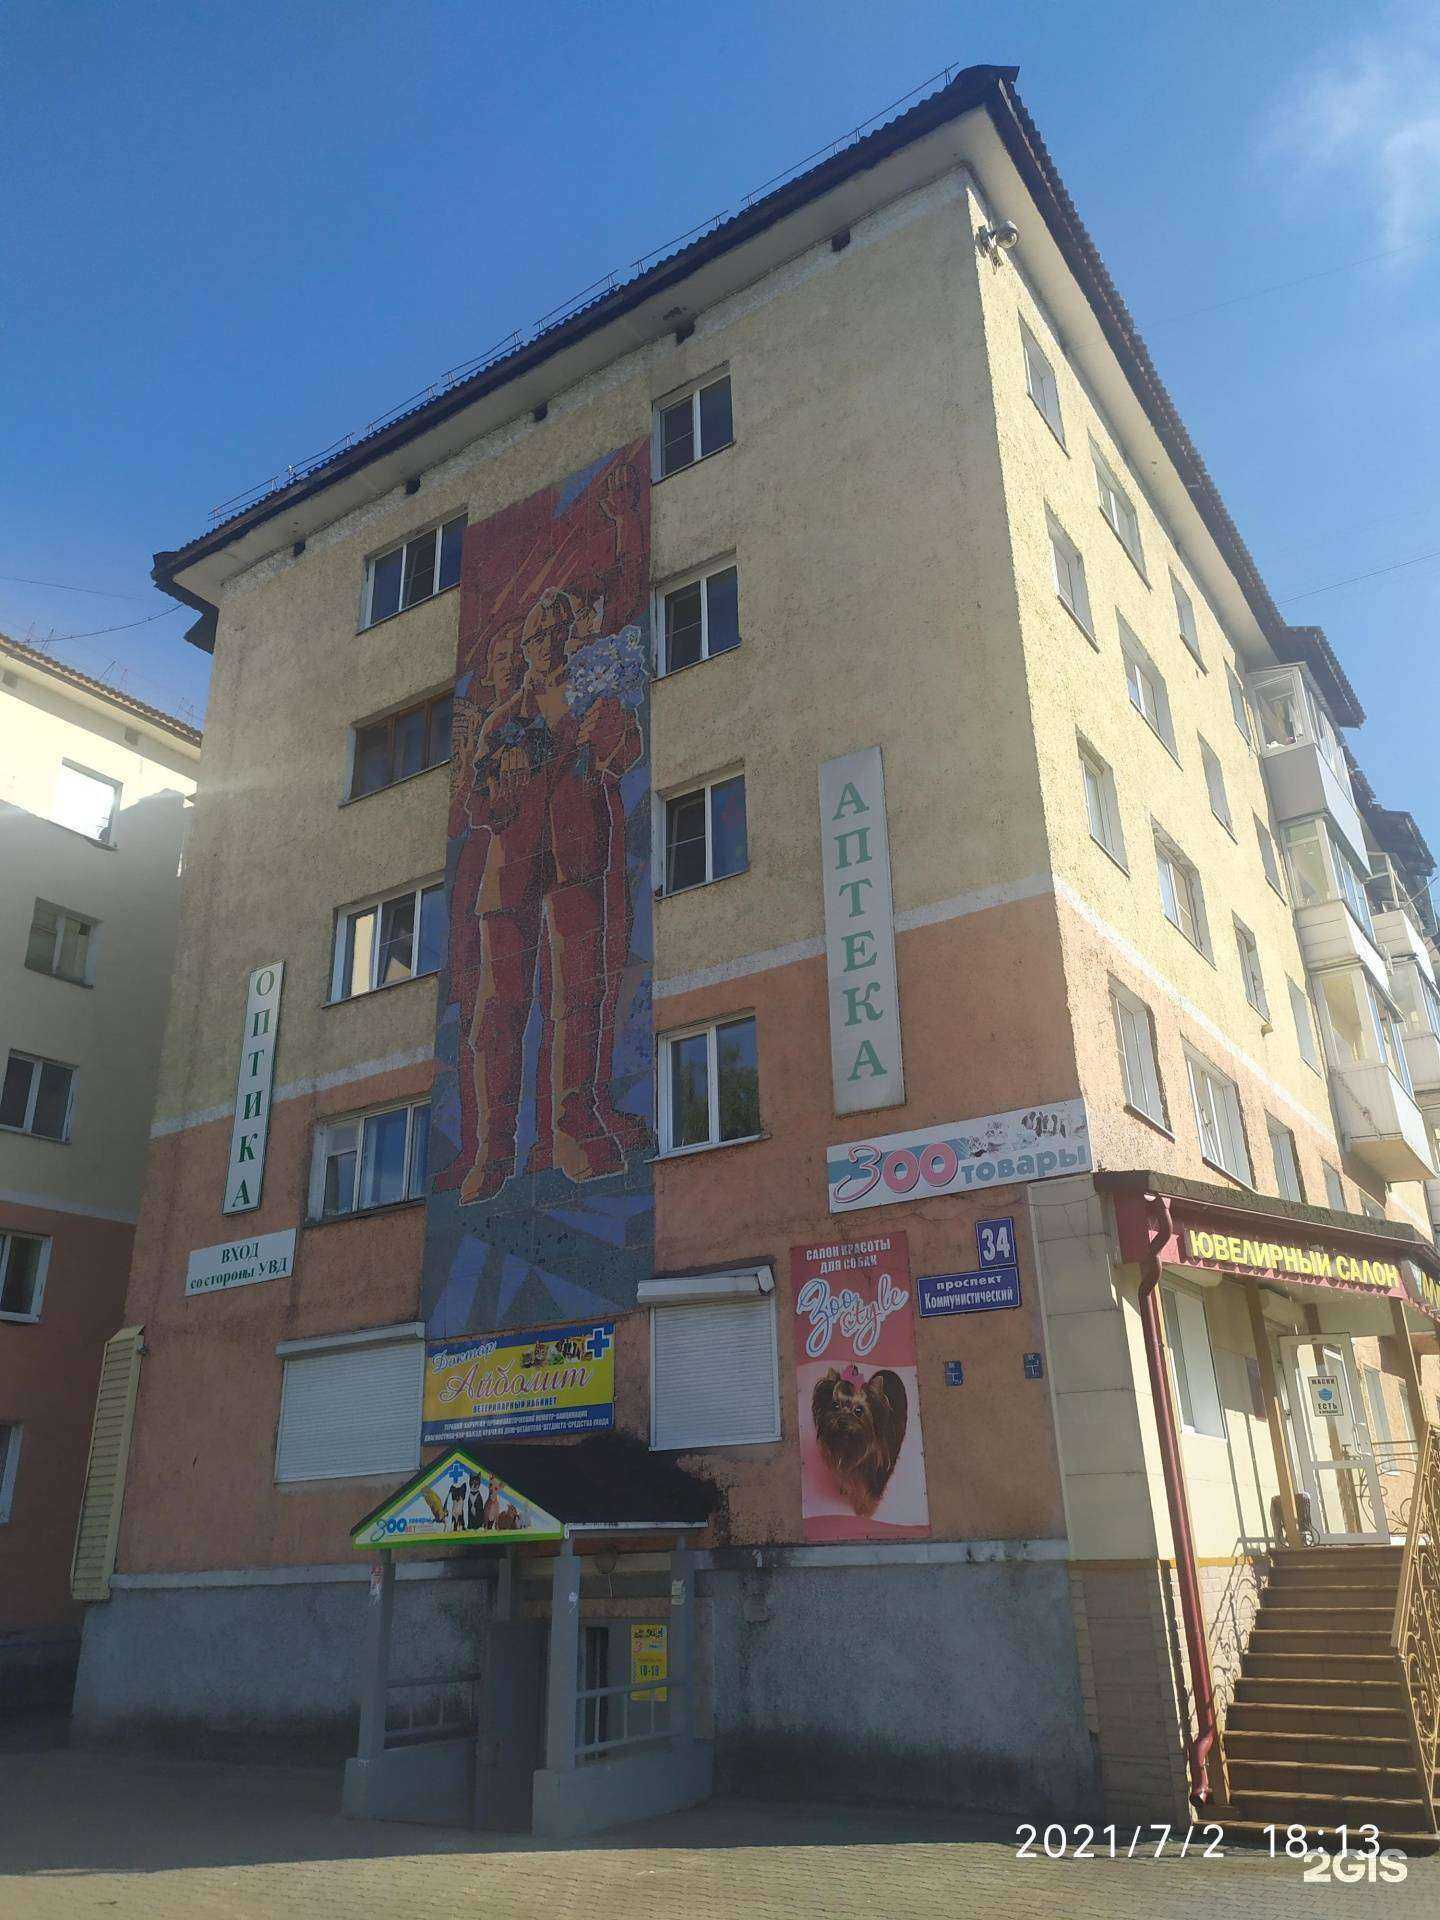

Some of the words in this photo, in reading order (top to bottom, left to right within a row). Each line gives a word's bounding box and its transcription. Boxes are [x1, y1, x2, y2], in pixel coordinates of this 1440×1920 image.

[832, 782, 887, 1081] АПТЕКА
[232, 970, 275, 1208] ОПТИКА
[961, 1145, 1087, 1184] товары
[221, 1242, 260, 1264] ВХОД
[806, 1246, 839, 1261] САЛОН
[841, 1238, 891, 1256] КРАСОТЫ
[981, 1226, 1011, 1261] 34
[1189, 1230, 1332, 1278] ЮВЕЛИРНЫЙ
[1336, 1255, 1400, 1289] САЛОН
[259, 1258, 288, 1276] УВД
[820, 1260, 841, 1274] ДЛЯ
[936, 1275, 1003, 1291] проспект
[925, 1286, 1013, 1309] Коммунистический
[797, 1278, 861, 1357] Zoo
[432, 1340, 498, 1374] Доктор
[439, 1360, 593, 1402] Айболит
[1318, 1402, 1338, 1410] ЕСТЬ
